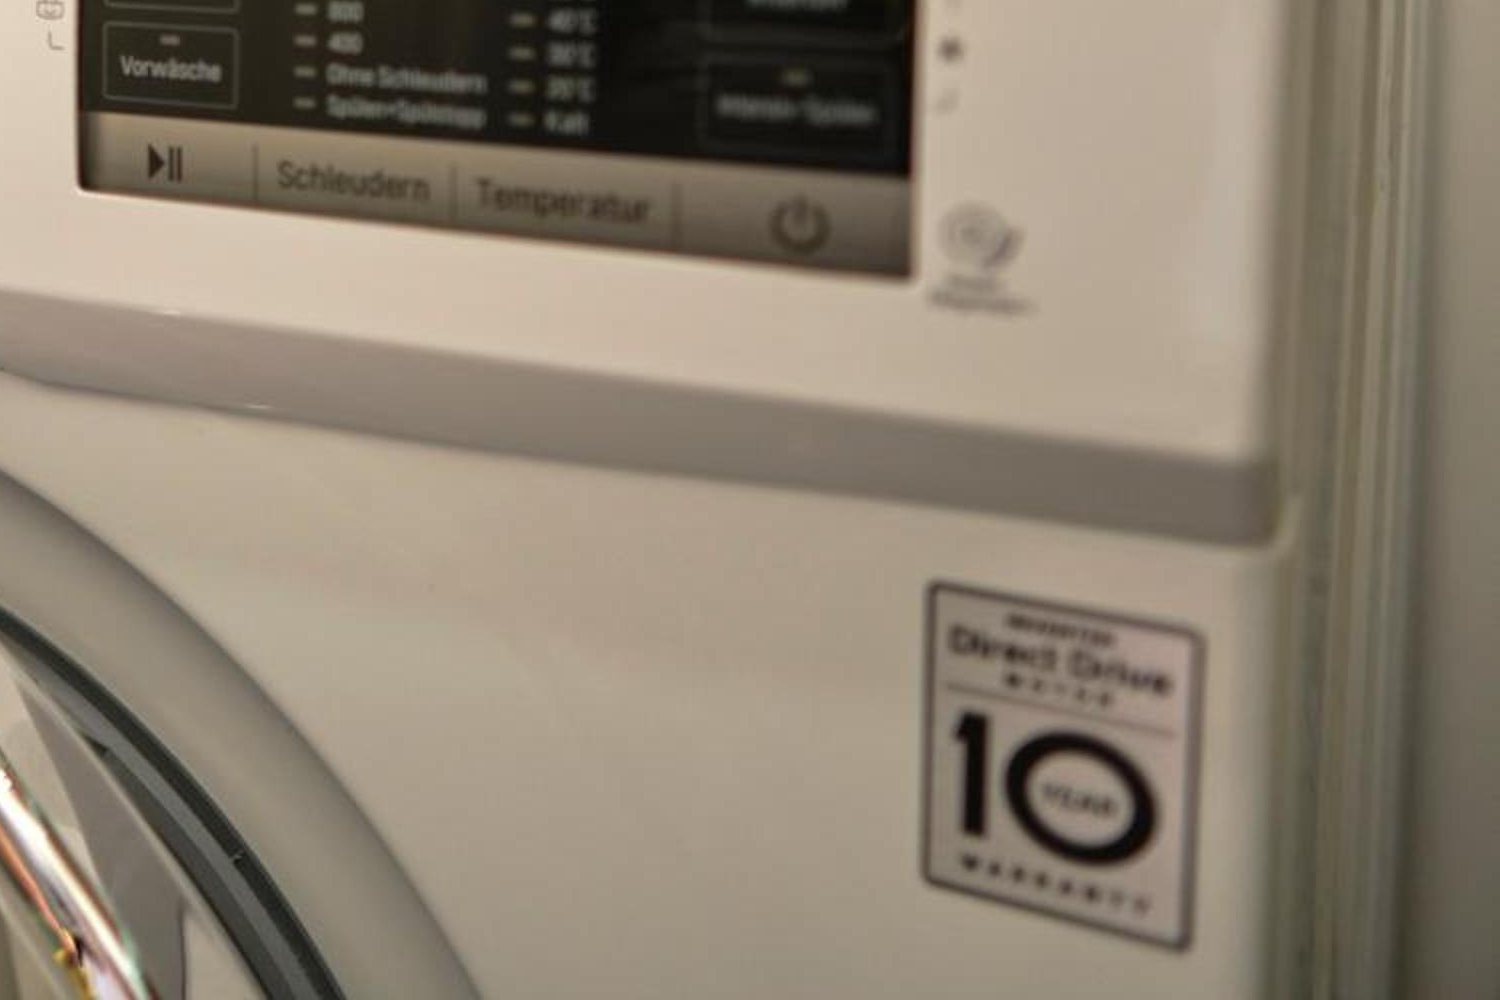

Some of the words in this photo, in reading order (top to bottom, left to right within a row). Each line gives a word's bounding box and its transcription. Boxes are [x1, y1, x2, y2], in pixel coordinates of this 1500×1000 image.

[119, 54, 223, 84] Vorwäsche
[275, 159, 432, 201] Schleudern
[475, 176, 651, 225] Temperatur
[955, 711, 1161, 869] 10
